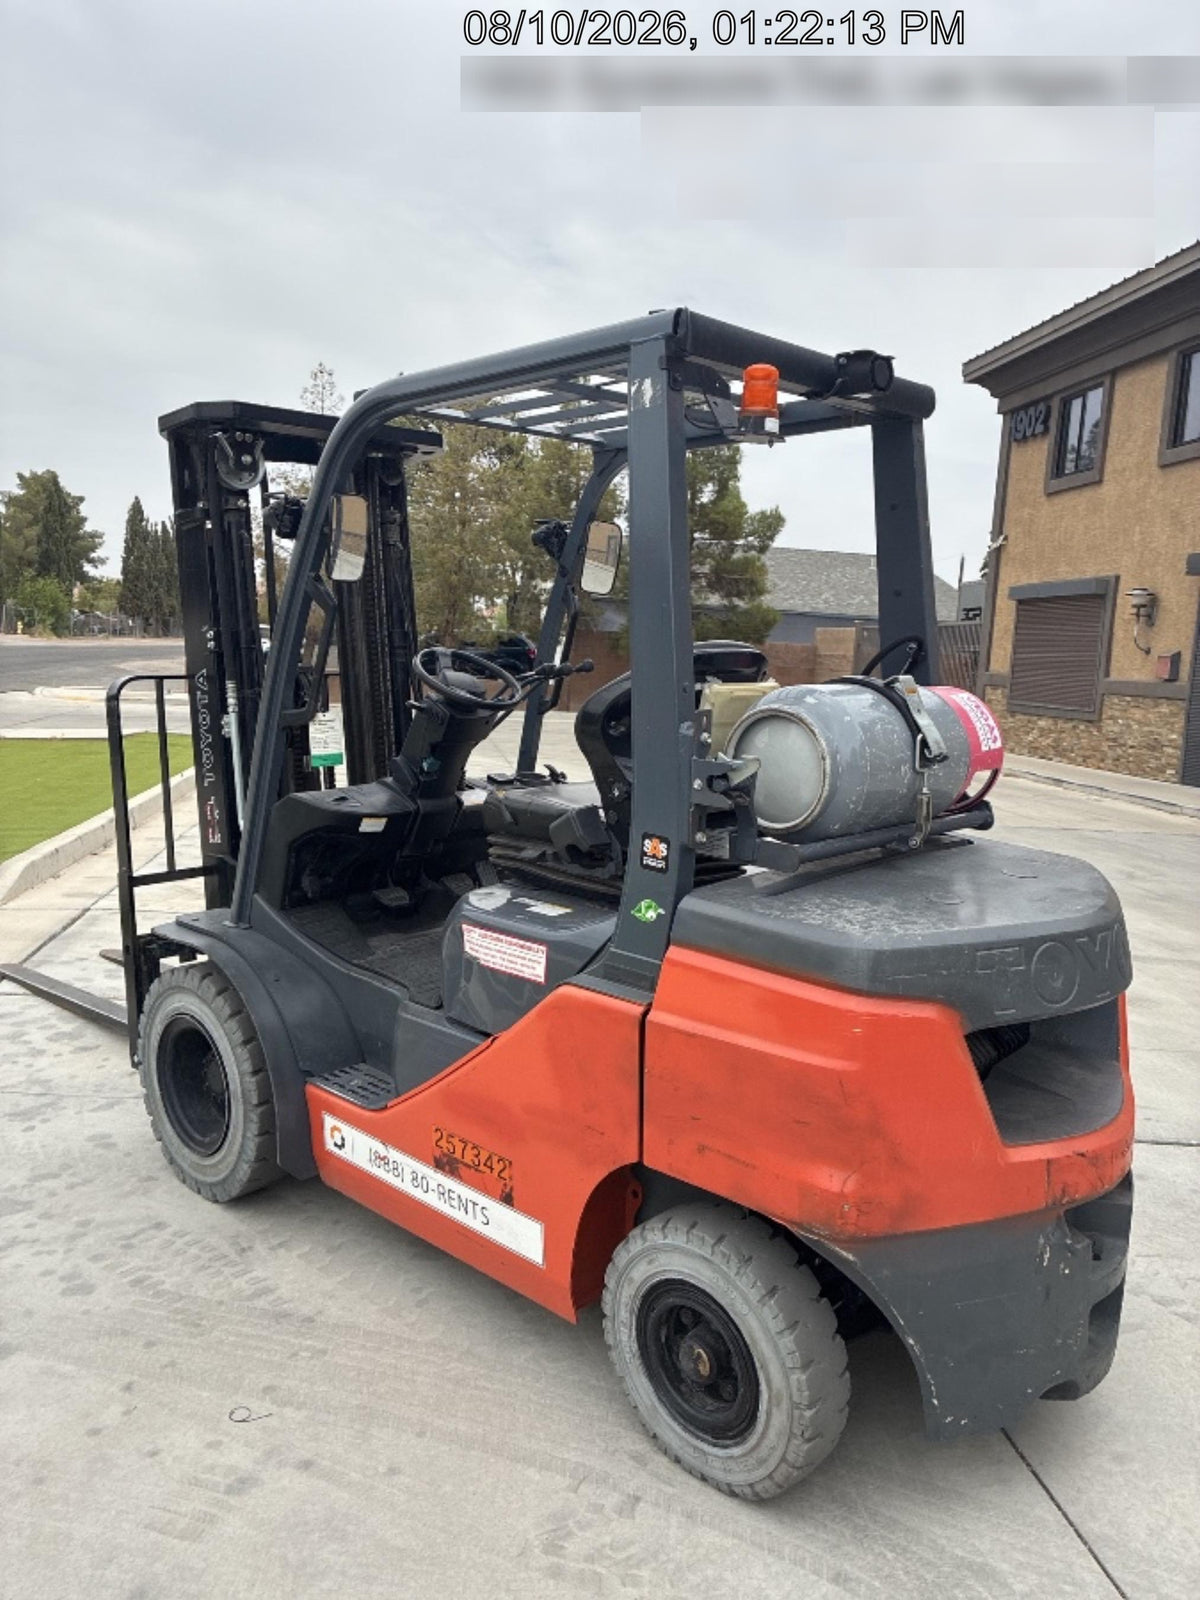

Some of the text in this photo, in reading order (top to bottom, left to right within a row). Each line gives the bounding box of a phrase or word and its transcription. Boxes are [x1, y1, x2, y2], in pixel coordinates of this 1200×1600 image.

[1011, 402, 1047, 441] 1902
[195, 668, 216, 787] TOYOTA
[434, 1126, 508, 1182] 257342
[410, 1170, 490, 1227] 80-RENTS
